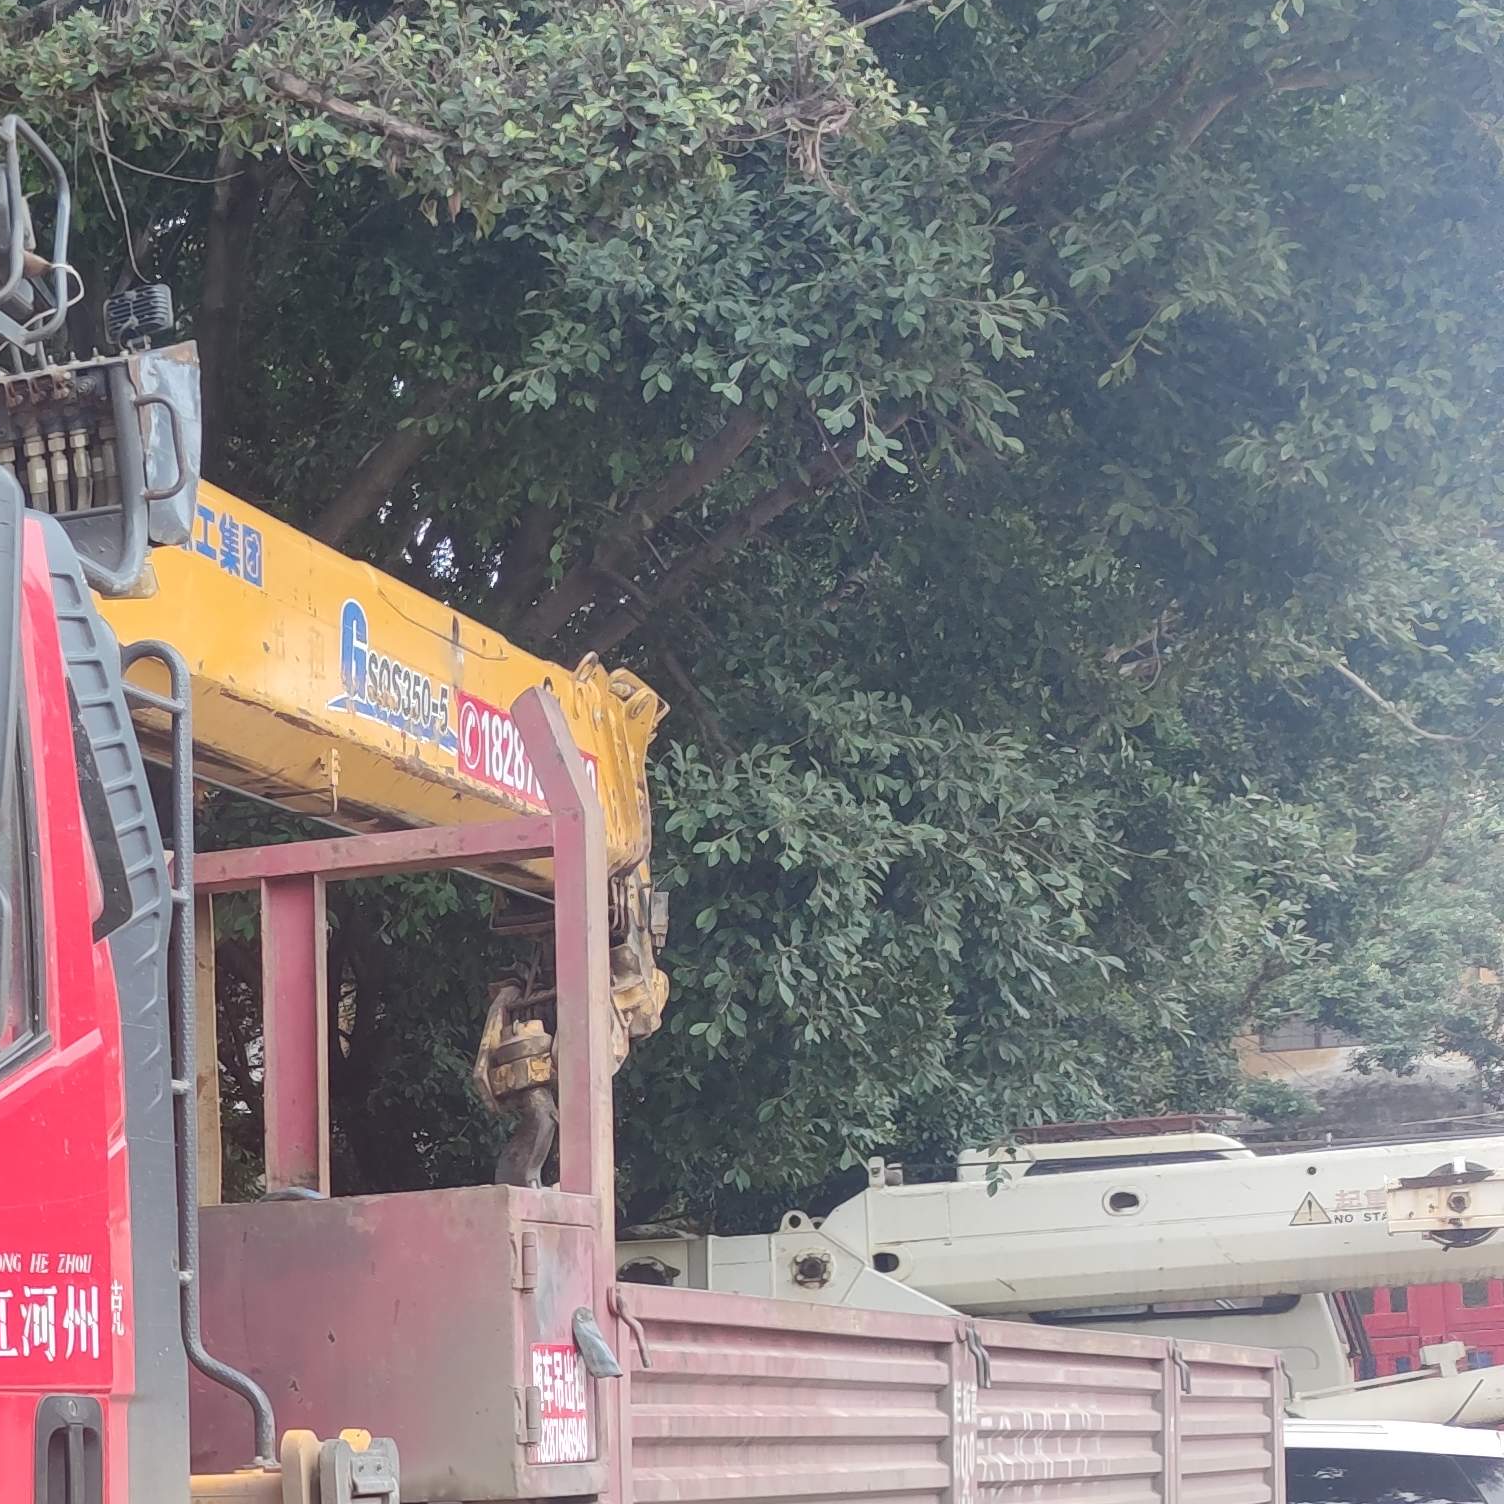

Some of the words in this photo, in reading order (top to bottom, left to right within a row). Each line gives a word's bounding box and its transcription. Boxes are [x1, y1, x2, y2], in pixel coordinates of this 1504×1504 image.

[182, 503, 263, 588] 工集团
[30, 1253, 49, 1274] HE
[57, 1253, 92, 1274] ZHOU
